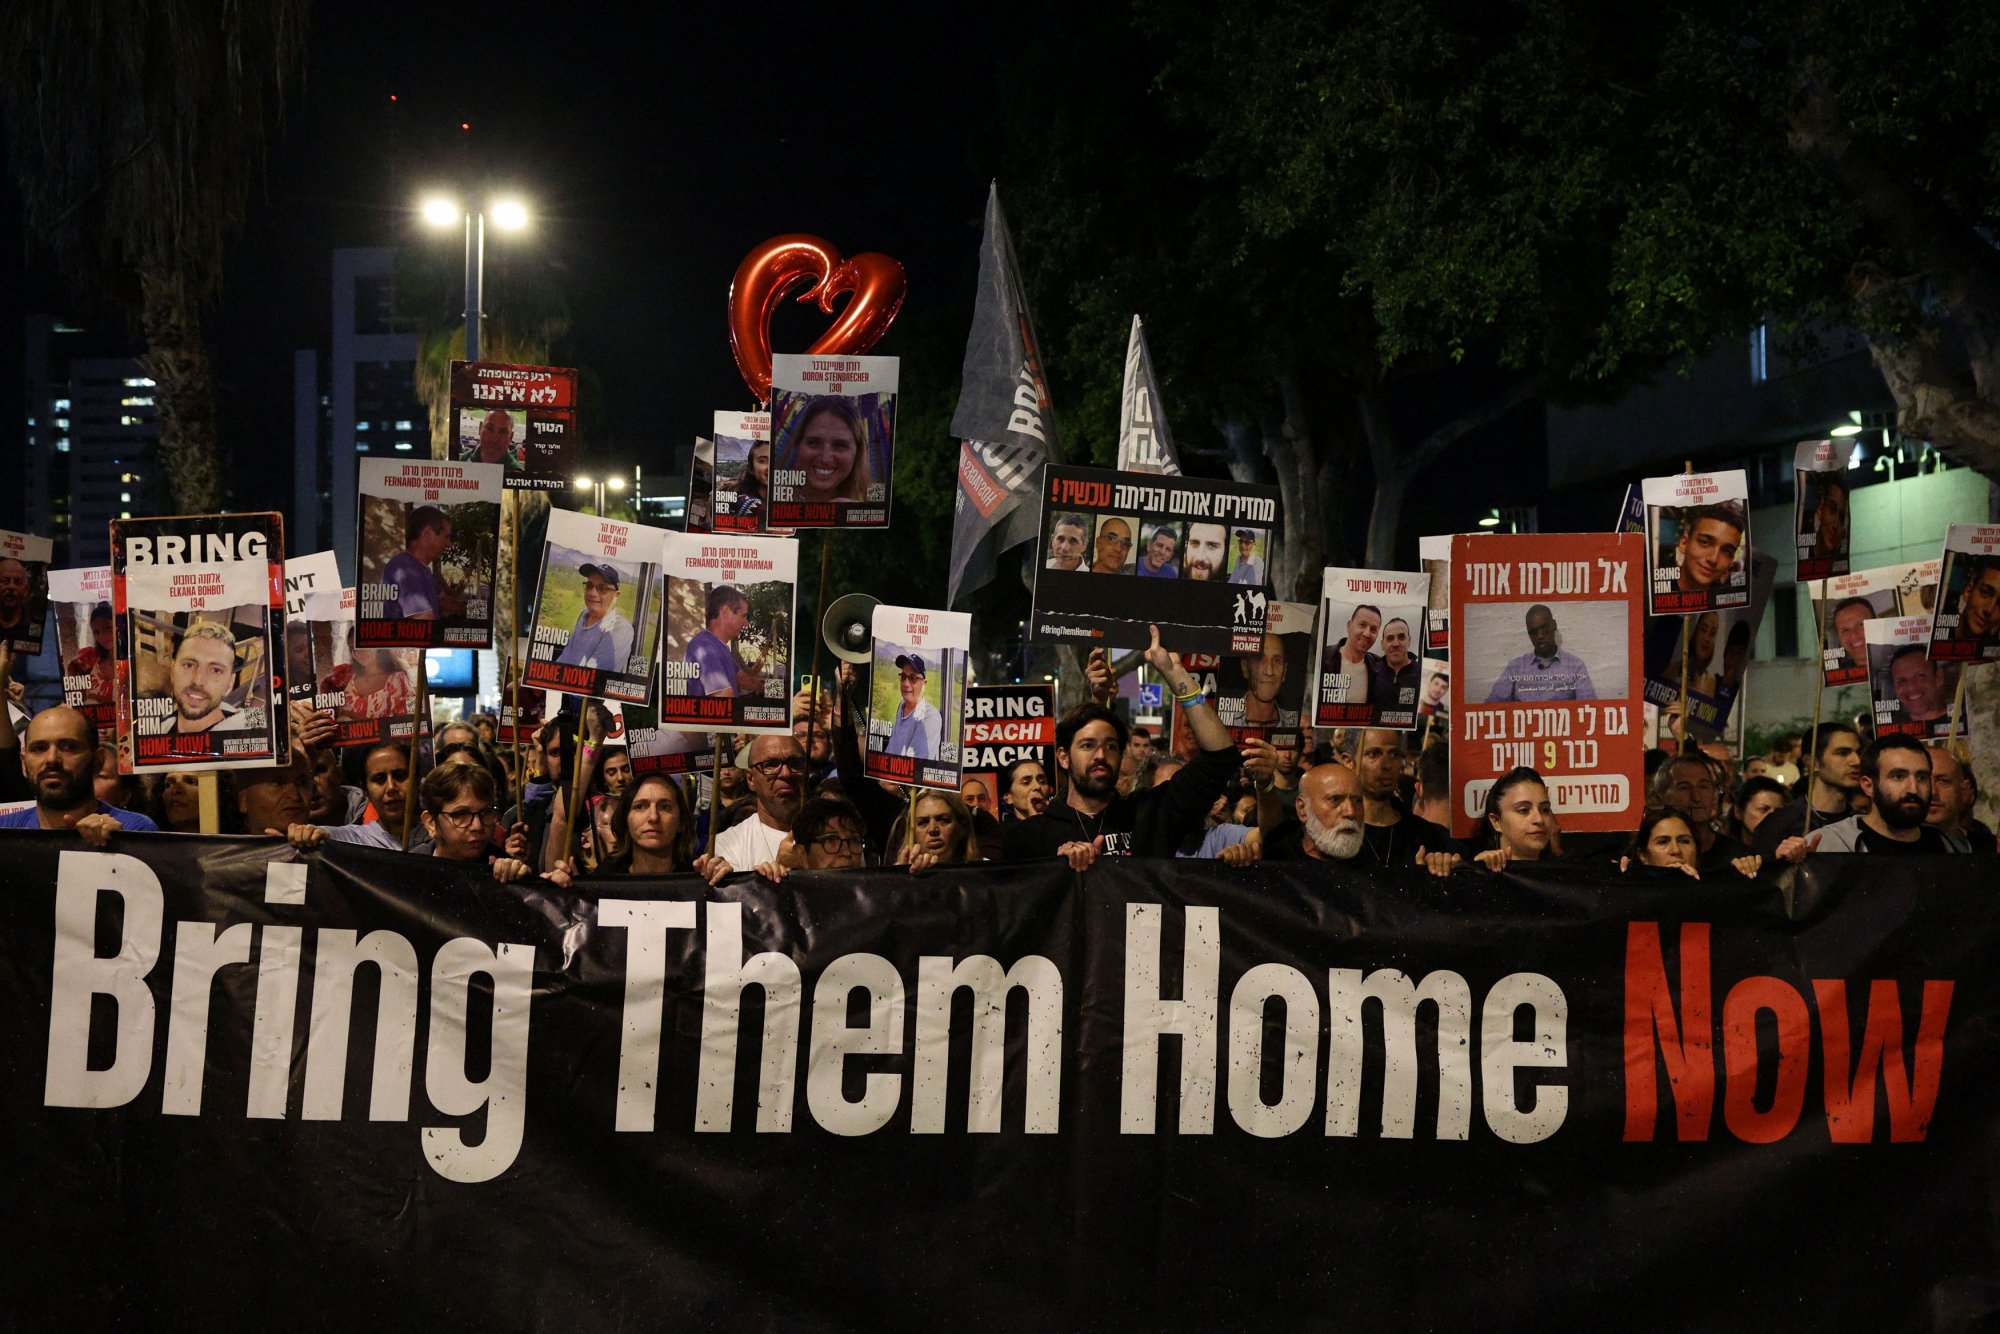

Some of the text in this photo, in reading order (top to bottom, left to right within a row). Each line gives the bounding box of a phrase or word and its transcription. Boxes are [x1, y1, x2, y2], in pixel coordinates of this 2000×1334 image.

[478, 369, 551, 382] רבע ממשפחת
[802, 372, 869, 383] DORON STEINBRECHER
[472, 383, 557, 404] לא איתנו
[534, 422, 563, 434] חטוף
[384, 476, 479, 490] FERNANDO SIMON MARMAN
[773, 469, 806, 486] BRING
[424, 490, 439, 501] (60)
[715, 491, 738, 503] BRING
[773, 487, 794, 502] HER
[1675, 485, 1719, 496] EDAN ALEXANDER
[1051, 478, 1274, 522] מחזירים אותם הביתה עכשיו!
[1631, 497, 1643, 517] TO
[715, 503, 729, 514] HER
[772, 504, 836, 519] HOME NOW!
[598, 533, 627, 547] LUIS HAR
[126, 532, 267, 565] BRING
[604, 545, 617, 556] (70)
[685, 557, 773, 570] FERNANDO SIMON MARMAN
[198, 573, 221, 584] אלקנה
[722, 570, 736, 580] (60)
[1465, 558, 1628, 596] אל תשכחו אותי
[1653, 567, 1680, 580] BRING
[80, 580, 104, 590] DANIELA
[170, 584, 225, 597] ELKANA BOHBOT
[362, 583, 398, 601] BRING
[1347, 579, 1407, 594] אלי ויוסי שרעבי
[1654, 581, 1671, 594] HIM
[190, 597, 205, 608] (34)
[1654, 594, 1680, 607] HOME
[1681, 592, 1708, 605] NOW!
[361, 602, 384, 618] HIM
[1430, 620, 1443, 631] HIM
[1937, 615, 1960, 627] BRING
[360, 621, 432, 639] HOME NOW!
[444, 633, 487, 642] FAMILIES FORUM
[534, 625, 570, 646] BRING
[1040, 625, 1104, 638] #BringThemHomeNow
[1934, 628, 1949, 640] HIM
[532, 642, 554, 661] HIM
[1232, 642, 1260, 651] HOME!
[1823, 648, 1846, 659] BRING
[666, 661, 700, 679] BRING
[1825, 660, 1839, 671] HIM
[528, 662, 560, 682] HOME
[562, 668, 597, 688] NOW!
[1323, 673, 1350, 688] BRING
[63, 675, 92, 691] BRING
[604, 685, 626, 696] FAMILIES
[666, 679, 687, 695] HIM
[66, 691, 84, 706] HER
[315, 691, 346, 708] BRING
[1322, 688, 1347, 703] THEM
[137, 698, 173, 717] BRING
[666, 698, 732, 716] HOME NOW!
[1219, 697, 1245, 712] BRING
[1320, 705, 1374, 719] HOME NOW!
[1875, 699, 1900, 712] BRING
[744, 711, 785, 721] FAMILIES FORUM
[1219, 712, 1235, 725] HIM
[1513, 708, 1571, 738] מחכים
[1578, 704, 1597, 736] לי
[1604, 707, 1629, 735] גם
[1876, 712, 1892, 724] HIM
[138, 717, 161, 735] HIM
[349, 720, 380, 738] NOW!
[870, 718, 892, 736] BRING
[965, 723, 1042, 741] TSACHI
[1464, 711, 1507, 740] בבית
[629, 728, 656, 742] BRING
[138, 734, 211, 757] HOME NOW!
[223, 744, 269, 754] FAMILIES FORUM
[630, 743, 651, 757] HIM
[869, 735, 883, 751] HIM
[634, 758, 659, 771] HOME
[661, 753, 687, 769] NOW!
[1491, 739, 1598, 771] כבר 9 שנים
[868, 755, 889, 772] HOME
[890, 757, 915, 776] NOW!
[1558, 783, 1620, 805] מחזירים
[44, 850, 1955, 1184] Bring Them Home Now
